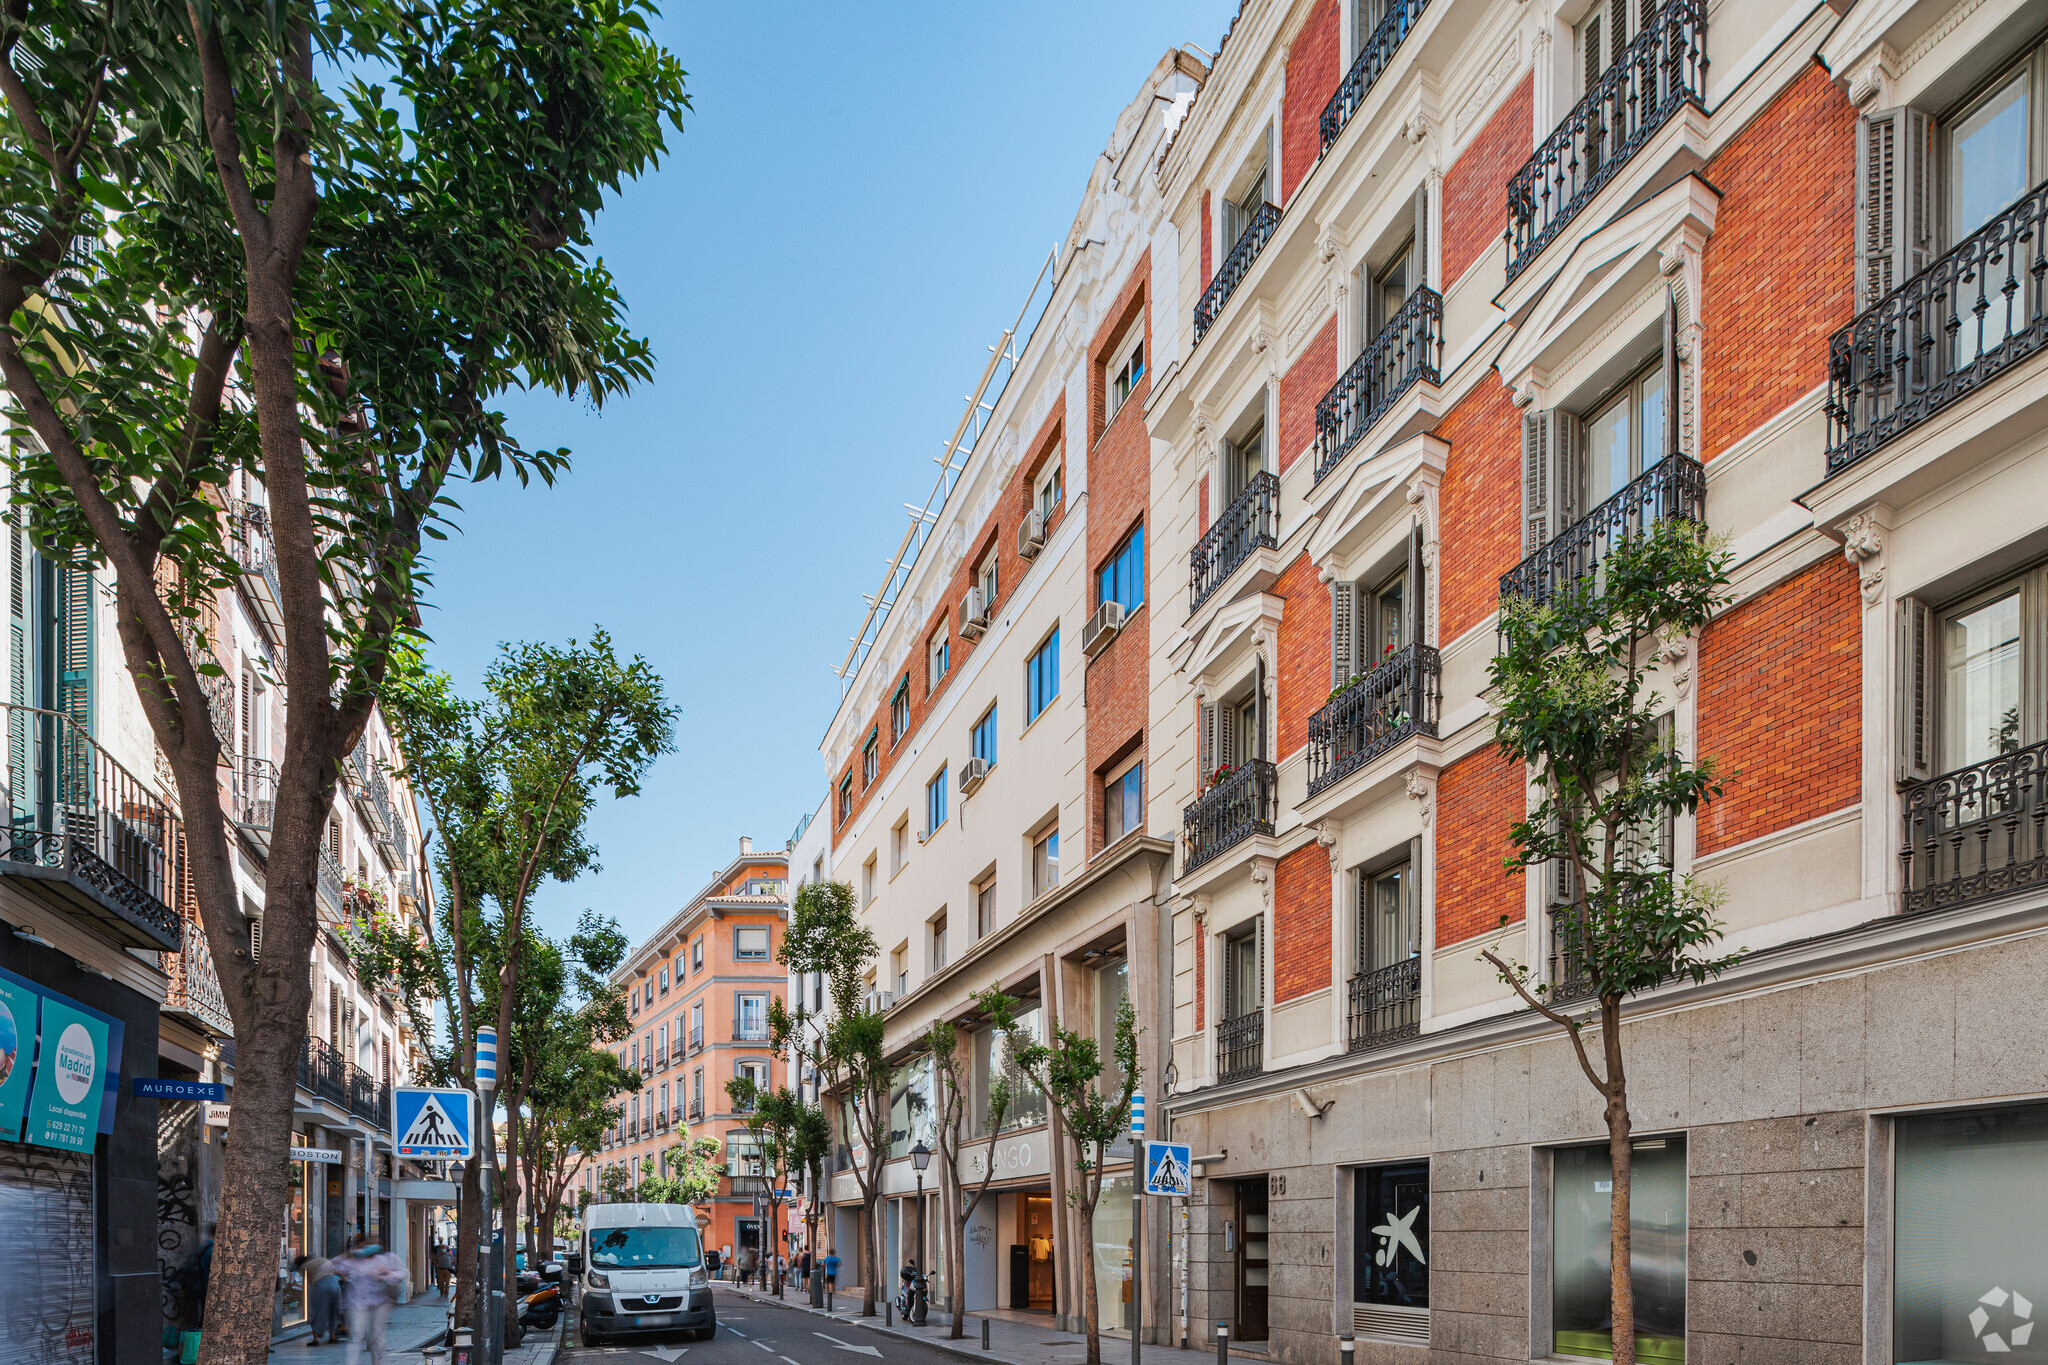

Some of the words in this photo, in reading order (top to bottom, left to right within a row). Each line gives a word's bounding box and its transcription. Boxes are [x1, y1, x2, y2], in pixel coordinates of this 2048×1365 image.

[59, 1053, 92, 1076] Madrid
[142, 1084, 214, 1096] MUROEXE
[48, 1104, 63, 1114] Local
[63, 1108, 87, 1120] disponible
[52, 1120, 63, 1131] 629
[63, 1123, 71, 1132] 22
[71, 1124, 78, 1134] 71
[79, 1126, 85, 1135] 72
[50, 1131, 57, 1141] 91
[976, 1143, 1031, 1176] MNGO
